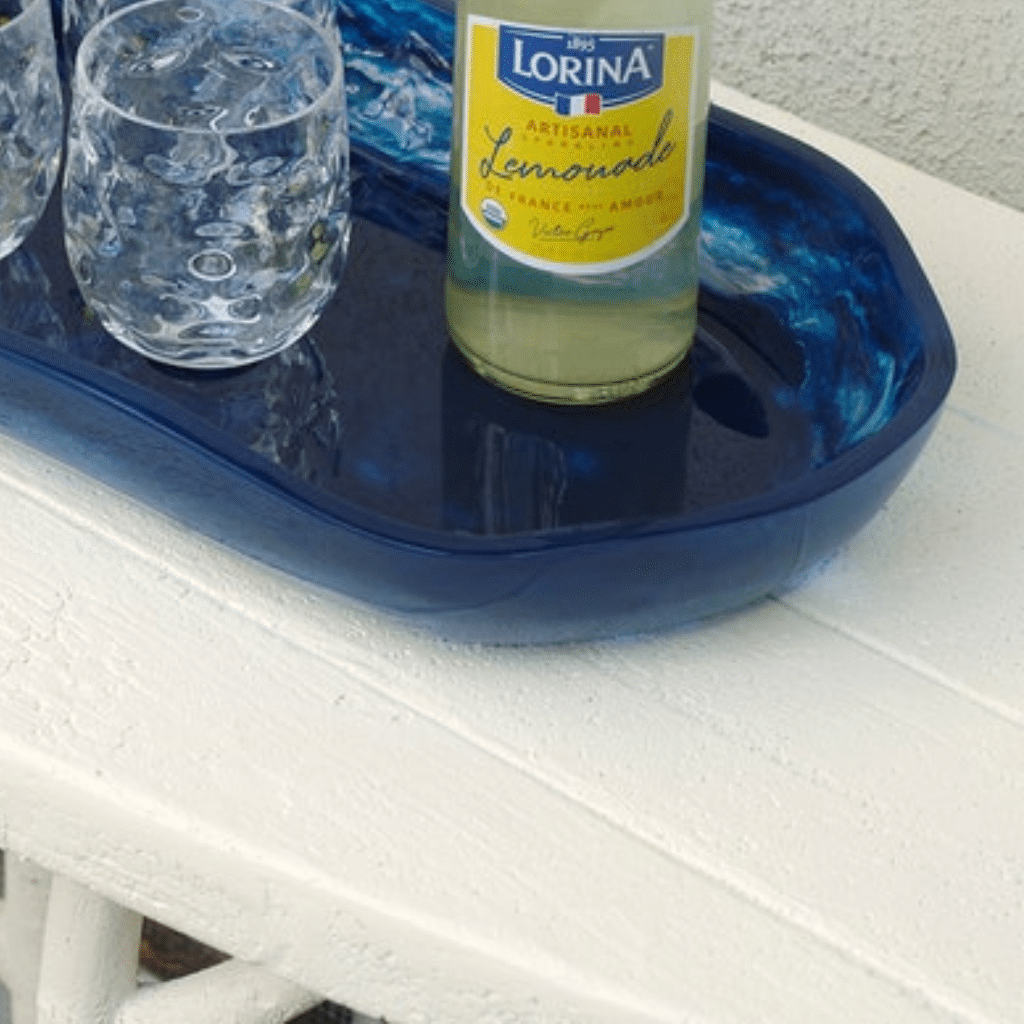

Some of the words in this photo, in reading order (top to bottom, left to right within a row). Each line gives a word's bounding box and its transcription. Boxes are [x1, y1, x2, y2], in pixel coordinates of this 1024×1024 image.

[512, 38, 652, 87] LORINA
[479, 108, 675, 182] Lemonade
[525, 118, 634, 140] ARTISANAL
[509, 190, 571, 214] FRANCE
